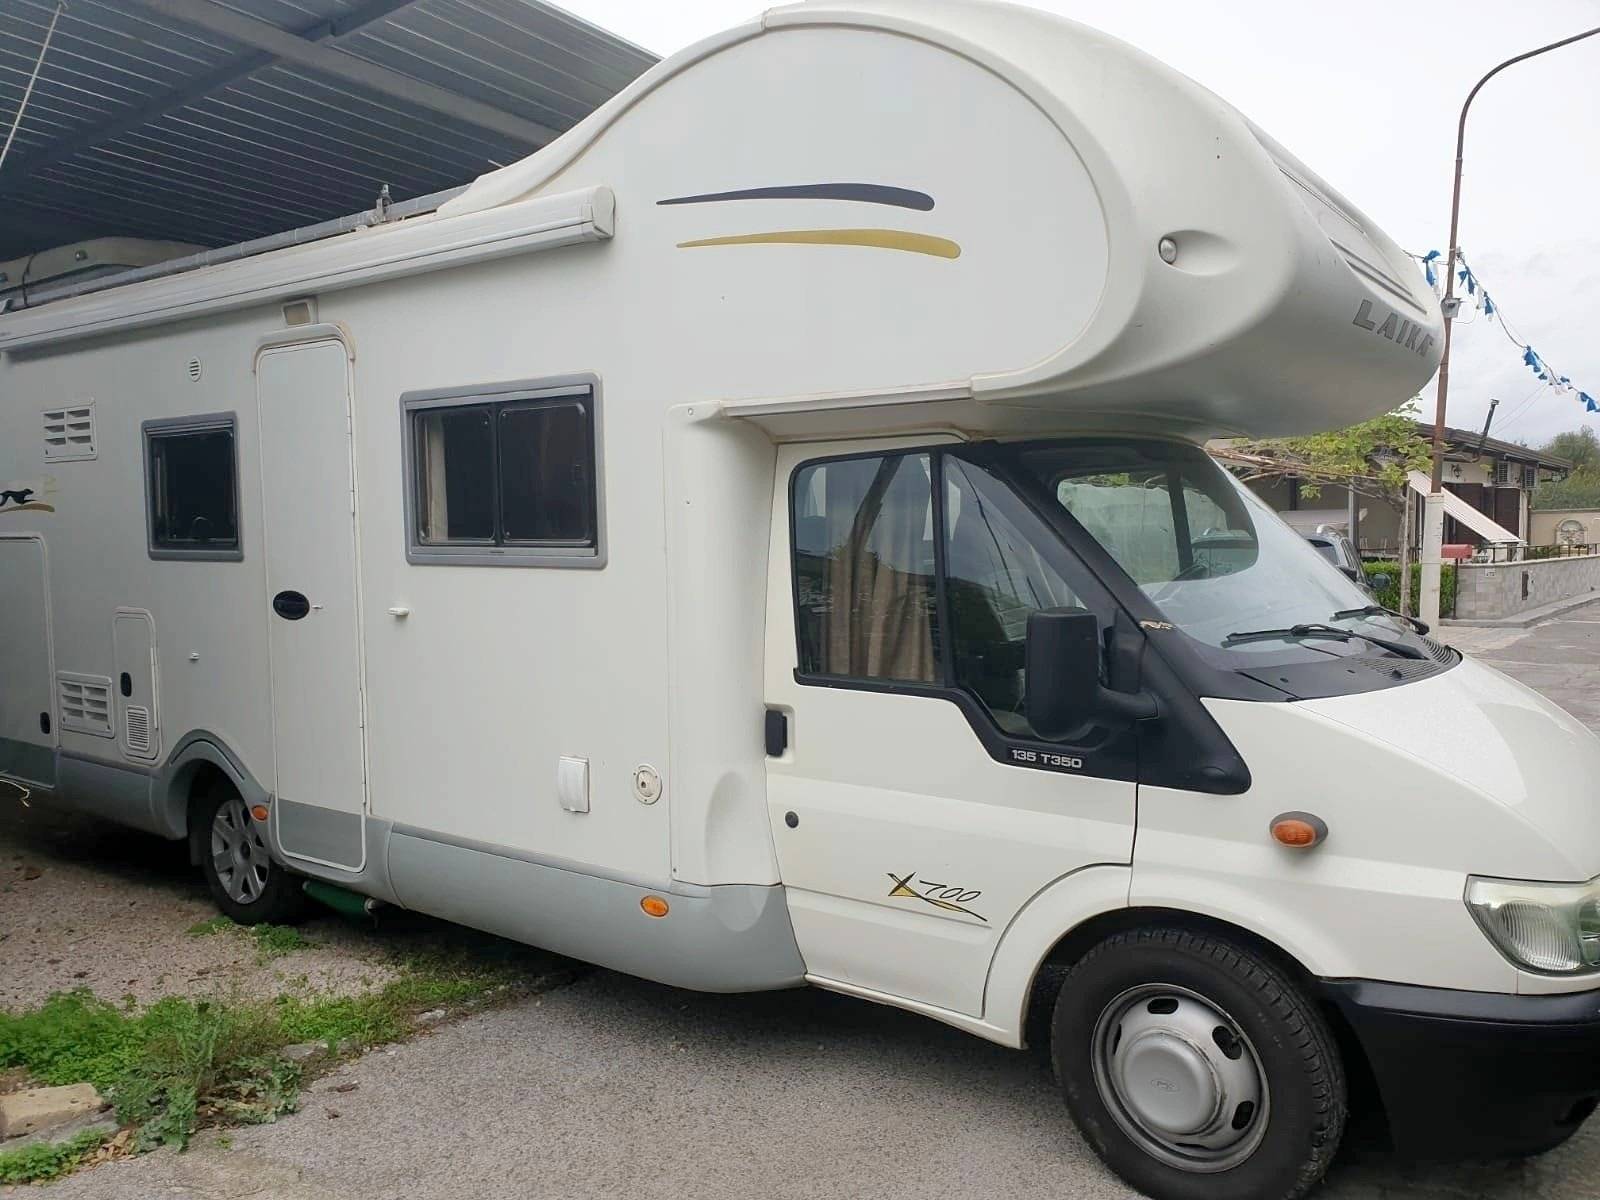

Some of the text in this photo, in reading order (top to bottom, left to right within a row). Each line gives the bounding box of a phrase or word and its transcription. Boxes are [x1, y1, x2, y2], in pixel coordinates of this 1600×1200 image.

[1352, 298, 1435, 358] LAIKA
[1011, 749, 1083, 769] 135 T350
